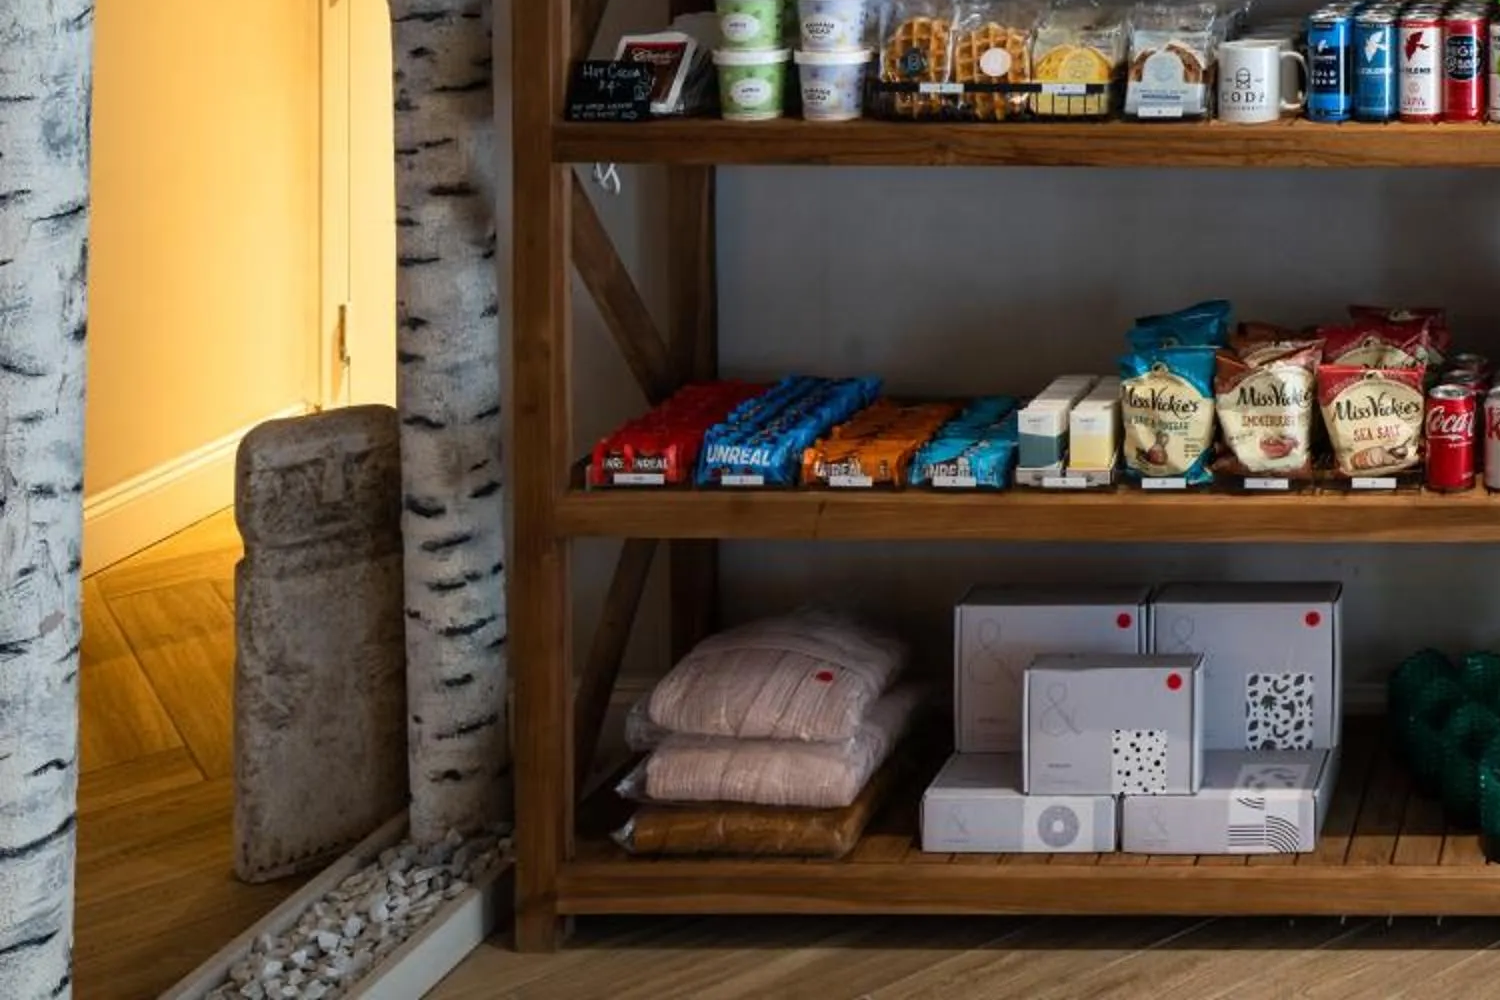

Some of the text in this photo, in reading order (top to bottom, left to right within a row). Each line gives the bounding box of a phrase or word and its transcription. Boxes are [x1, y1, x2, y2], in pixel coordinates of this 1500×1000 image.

[1237, 386, 1274, 407] Miss
[1334, 400, 1370, 422] Miss
[1353, 424, 1401, 442] SEA SALT
[706, 445, 772, 467] UNREAL
